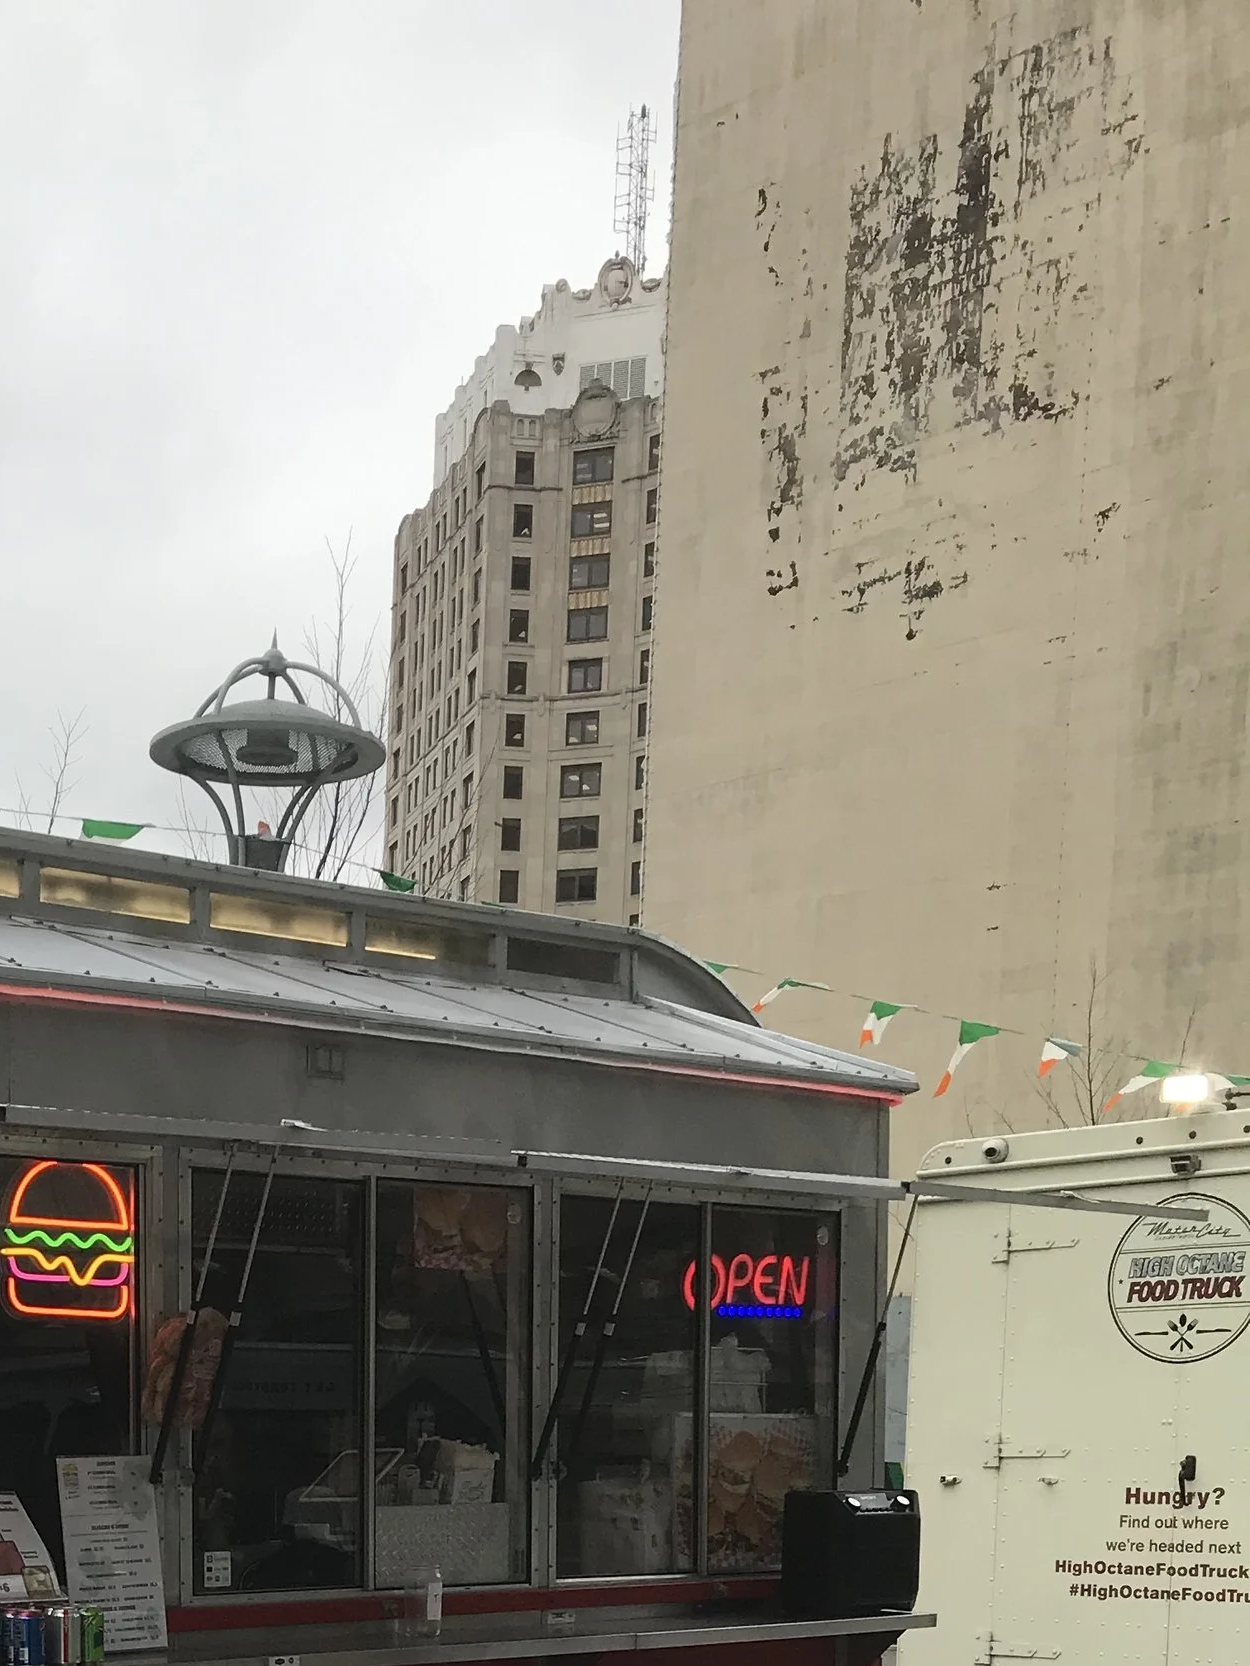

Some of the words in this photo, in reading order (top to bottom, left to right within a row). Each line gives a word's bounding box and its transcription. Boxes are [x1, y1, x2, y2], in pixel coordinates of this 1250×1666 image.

[1128, 1255, 1174, 1279] HIGH
[1176, 1251, 1247, 1276] OCTANE
[682, 1253, 810, 1311] OPEN
[1126, 1277, 1179, 1304] FOOD
[1181, 1275, 1247, 1301] TRUCK
[1125, 1487, 1225, 1510] Hungry?
[1119, 1515, 1150, 1529] Find
[1154, 1515, 1178, 1529] out
[1182, 1516, 1229, 1530] where
[1106, 1539, 1145, 1552] we're
[1149, 1539, 1203, 1554] headed
[1208, 1541, 1241, 1555] next
